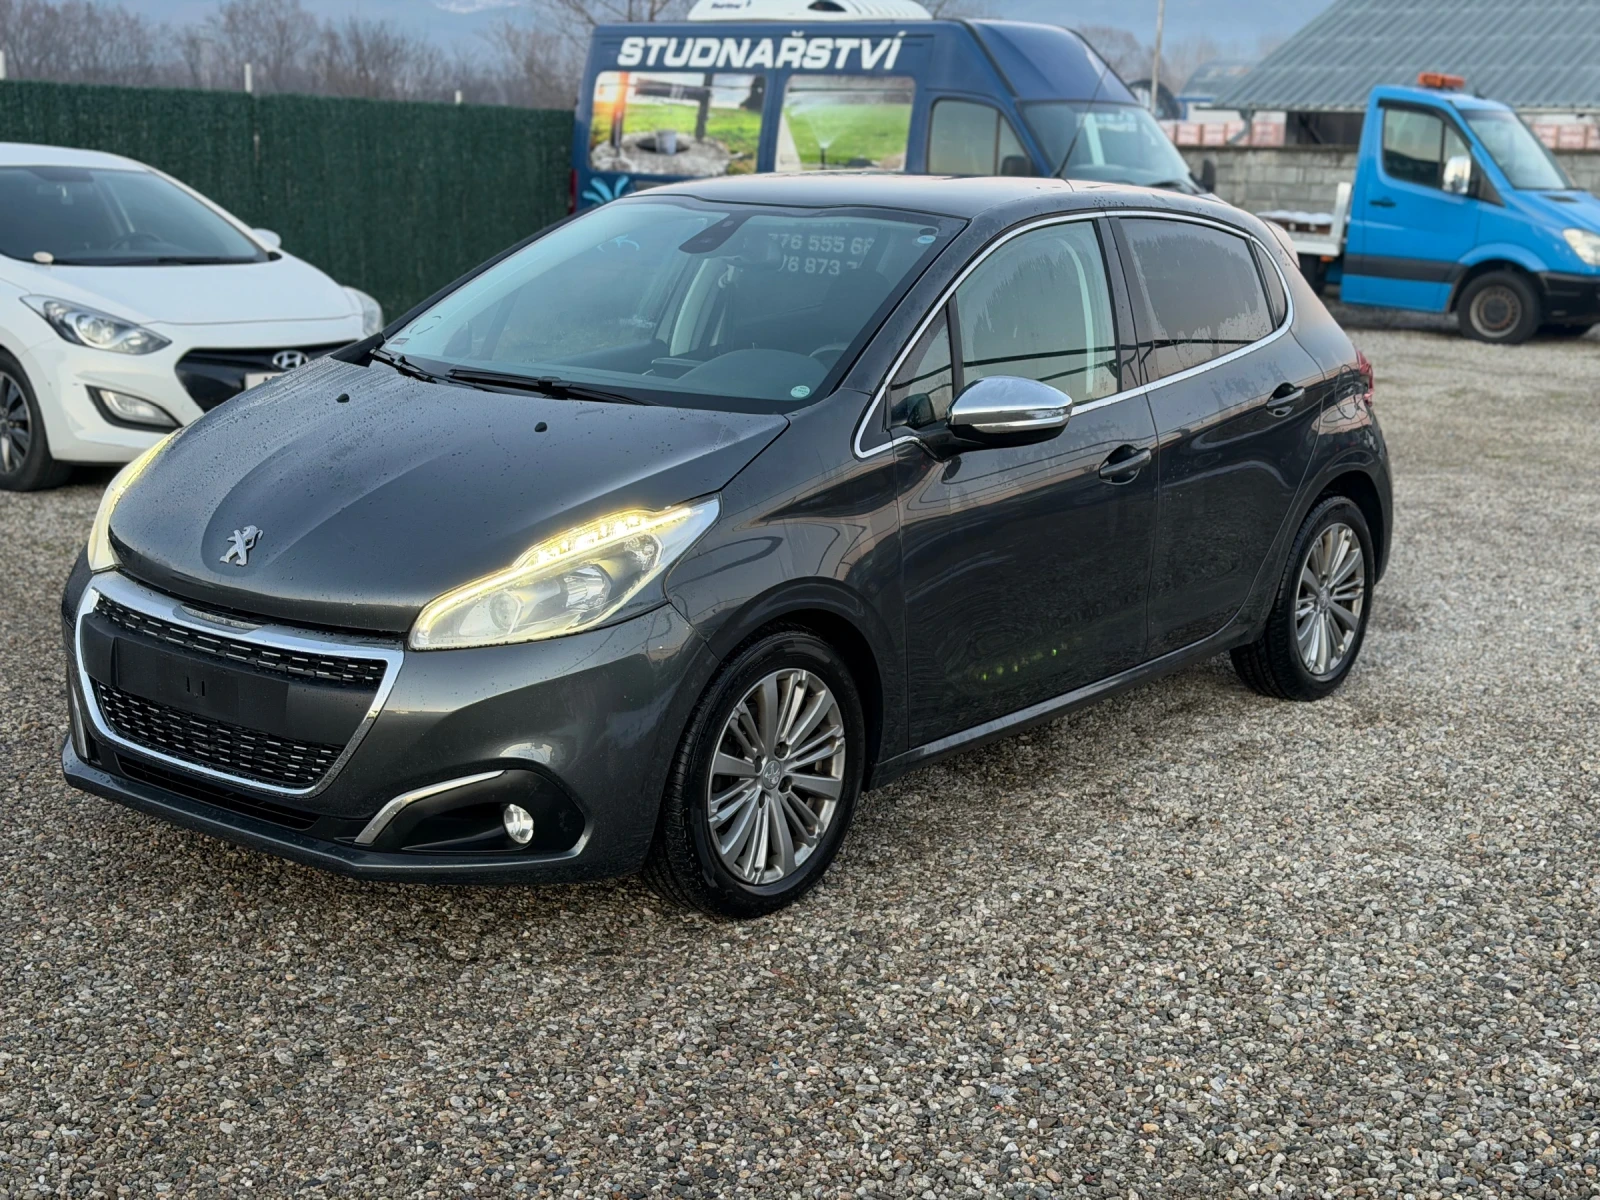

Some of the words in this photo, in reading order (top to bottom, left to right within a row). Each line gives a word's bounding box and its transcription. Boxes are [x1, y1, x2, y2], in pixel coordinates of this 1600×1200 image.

[617, 31, 906, 69] STUDNAŘSTVÍ
[808, 235, 845, 253] 555
[804, 257, 840, 276] 873
